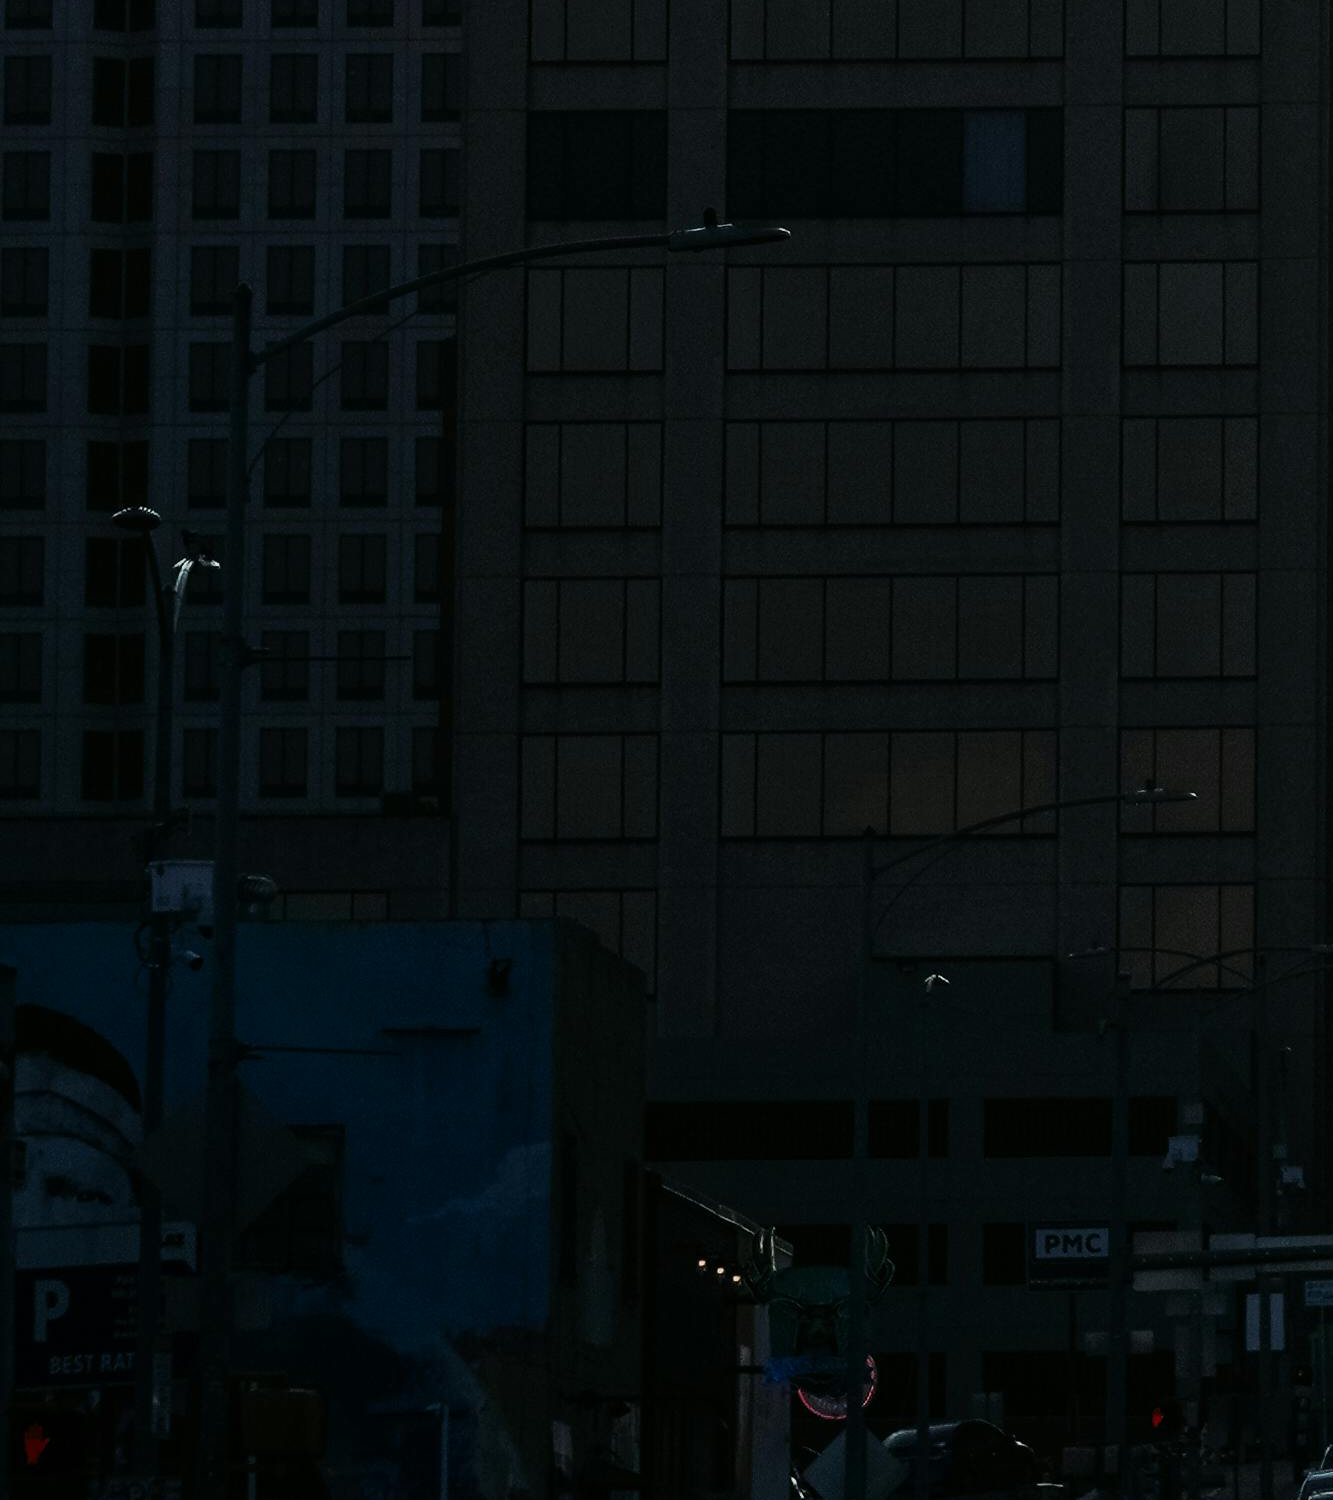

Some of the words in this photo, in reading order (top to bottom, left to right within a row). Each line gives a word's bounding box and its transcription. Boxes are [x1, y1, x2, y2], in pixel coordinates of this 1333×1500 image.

[1045, 1234, 1101, 1253] PMC
[33, 1279, 70, 1343] P
[49, 1353, 94, 1375] BEST
[100, 1352, 136, 1372] RAT
